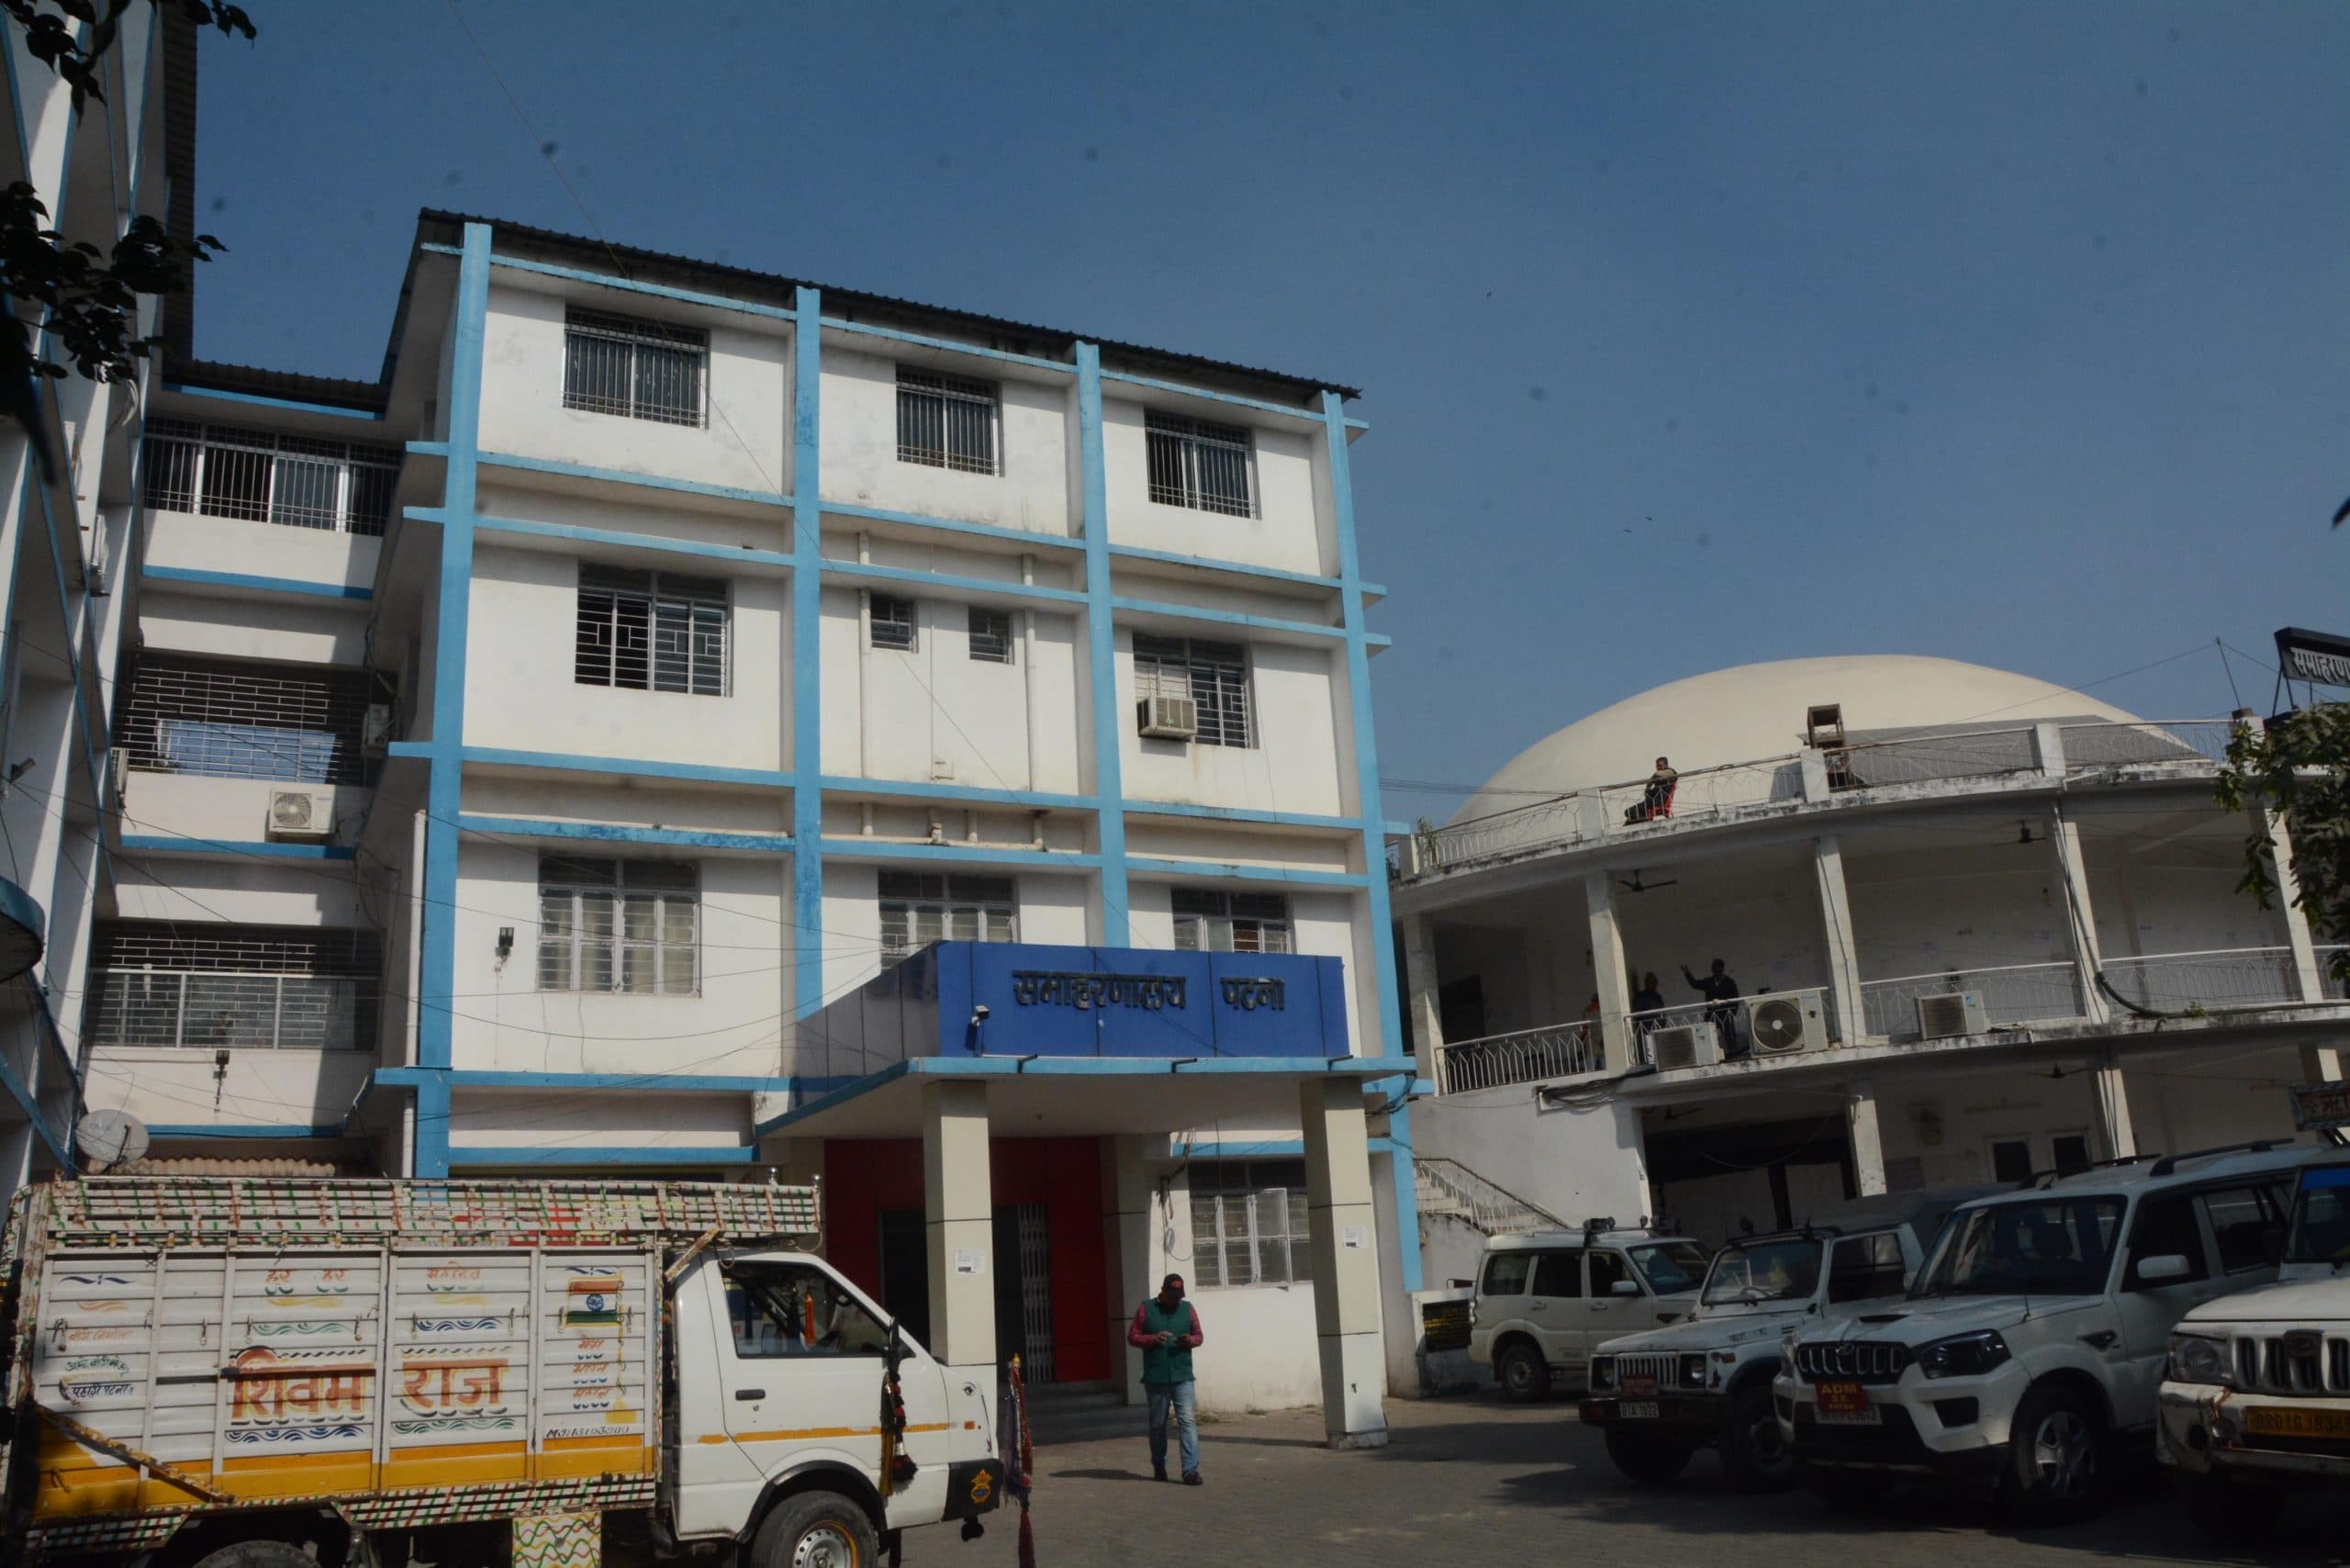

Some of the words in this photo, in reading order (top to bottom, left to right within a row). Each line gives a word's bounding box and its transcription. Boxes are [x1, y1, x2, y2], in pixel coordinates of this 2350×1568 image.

[1013, 969, 1186, 1010] समाहरणालय
[1220, 976, 1284, 1011] पटना
[231, 1346, 375, 1418] शिवम
[402, 1359, 509, 1409] राज
[1820, 1383, 1857, 1394] ADM
